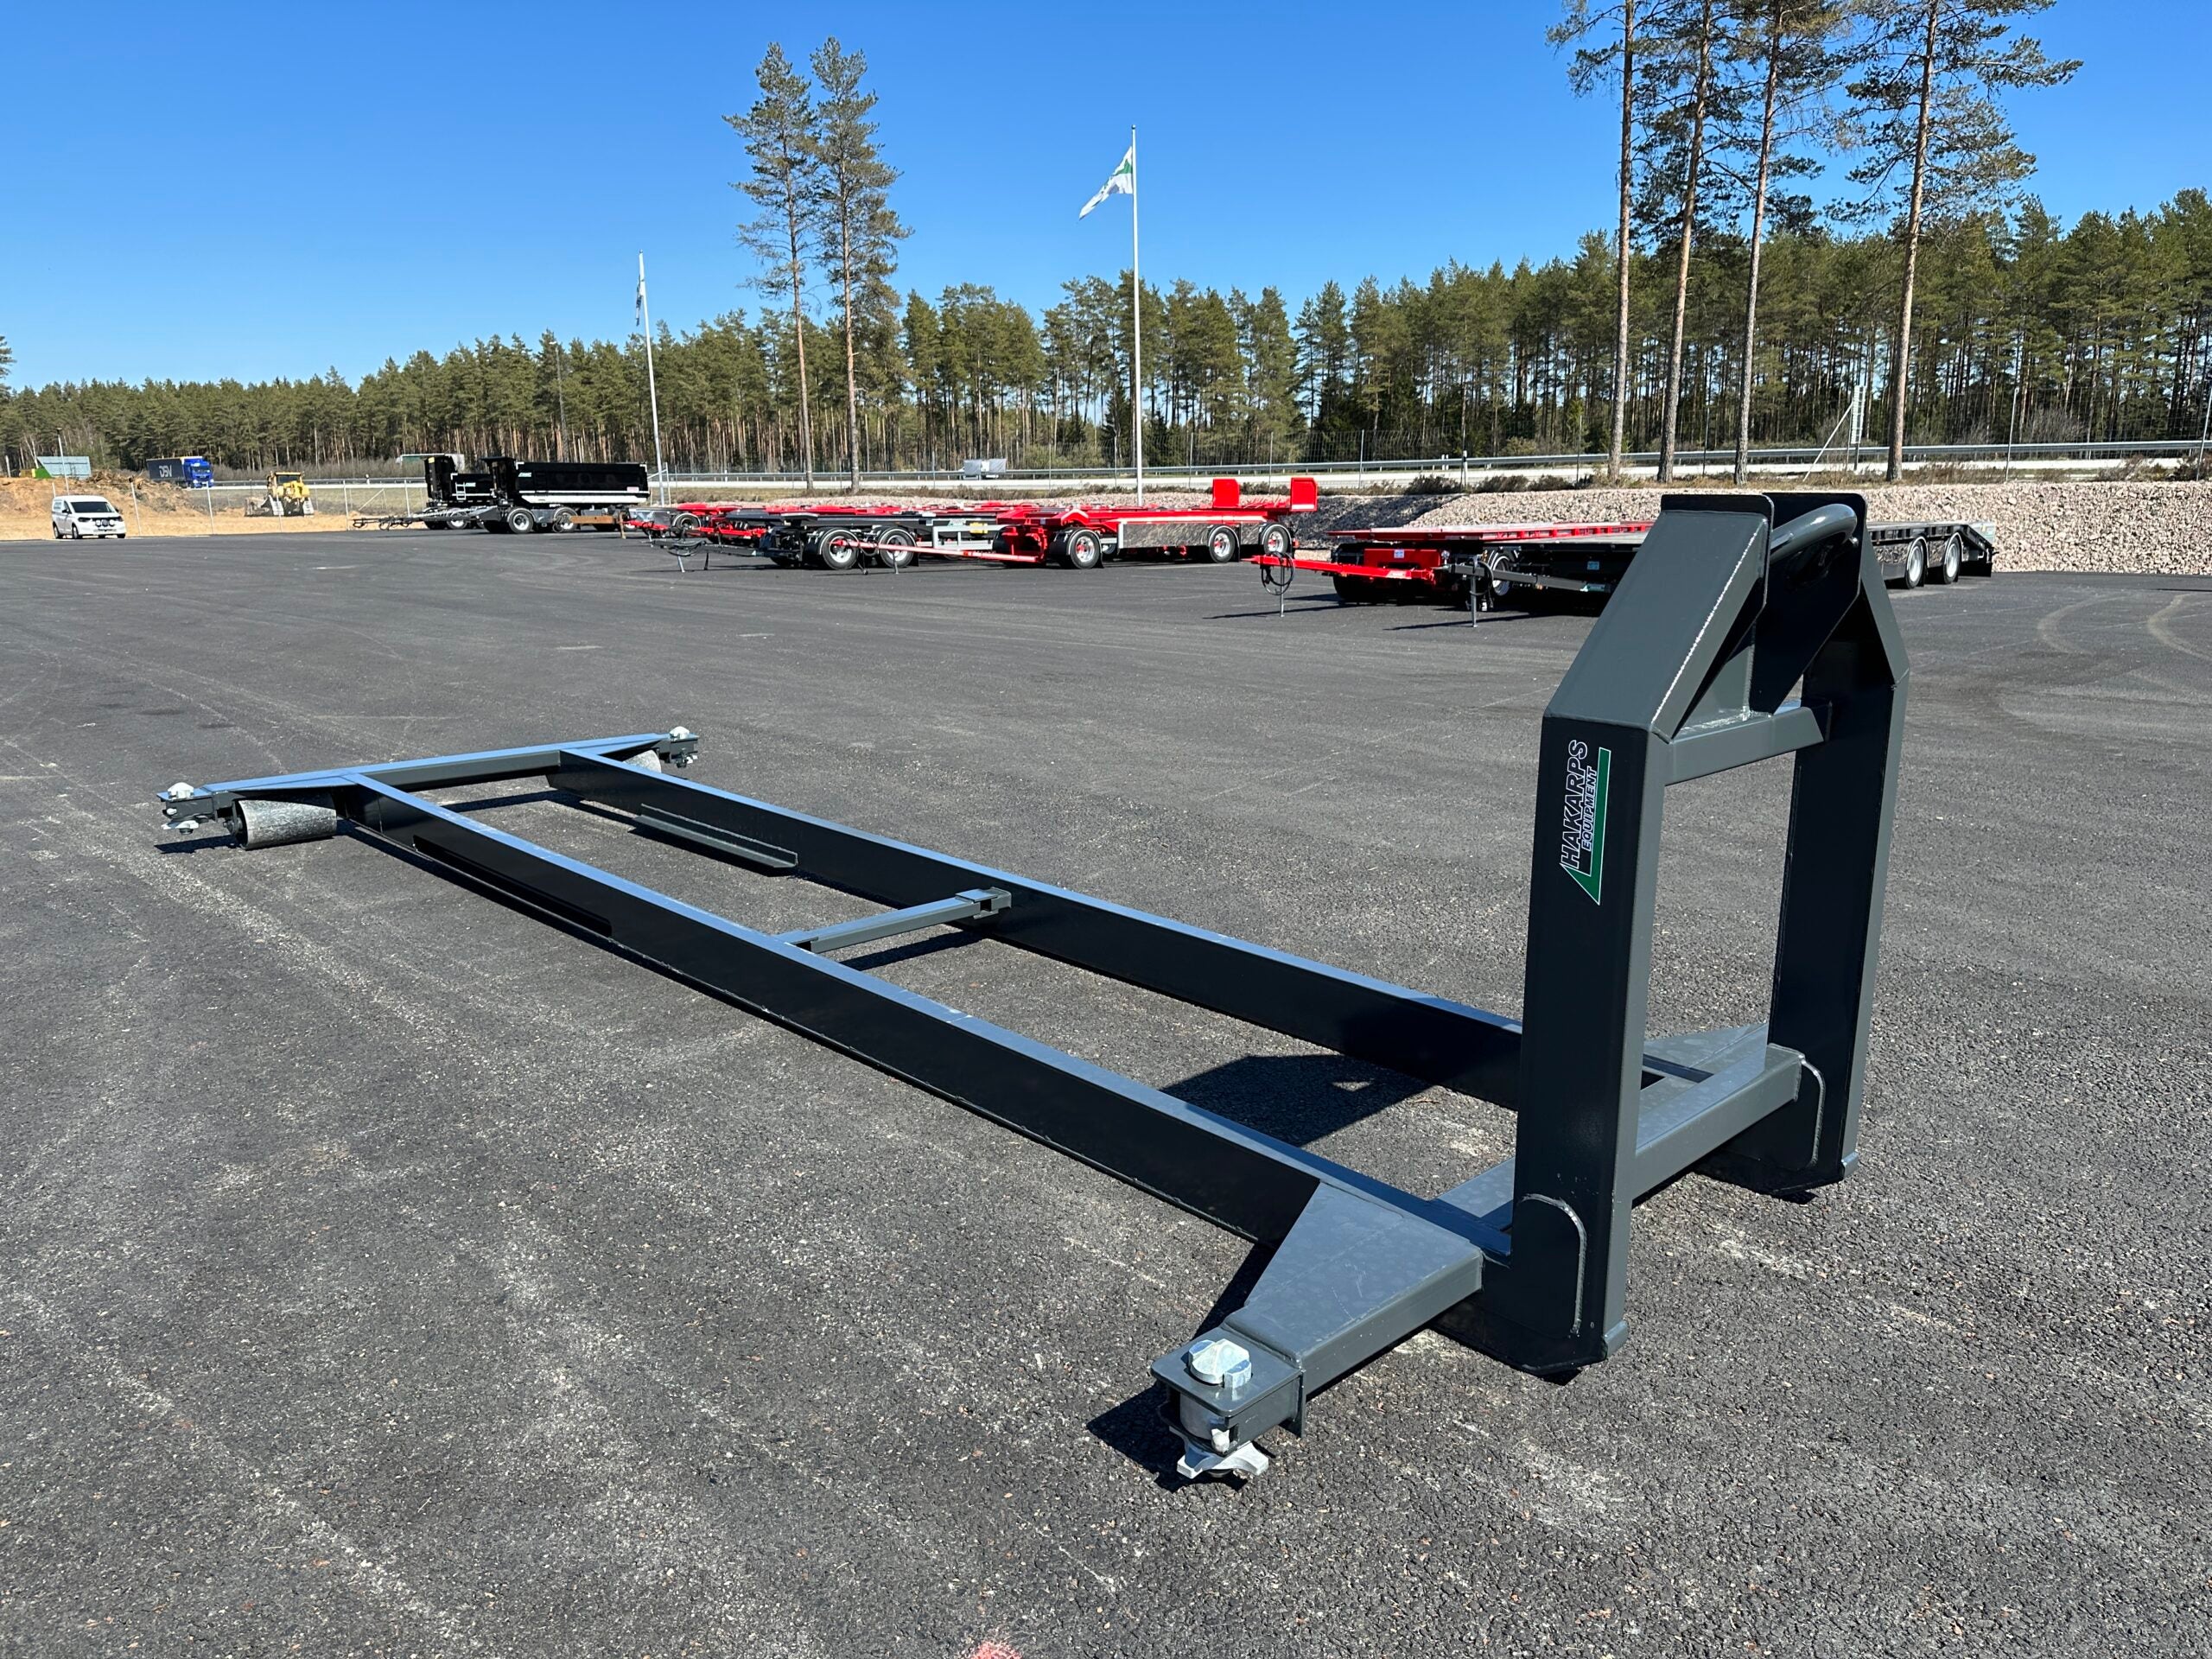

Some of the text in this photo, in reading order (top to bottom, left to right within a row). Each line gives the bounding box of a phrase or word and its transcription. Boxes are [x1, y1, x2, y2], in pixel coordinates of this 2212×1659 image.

[158, 465, 173, 478] DSV
[1560, 740, 1588, 869] HAKARPS
[1581, 766, 1599, 852] EQUIPMENT
